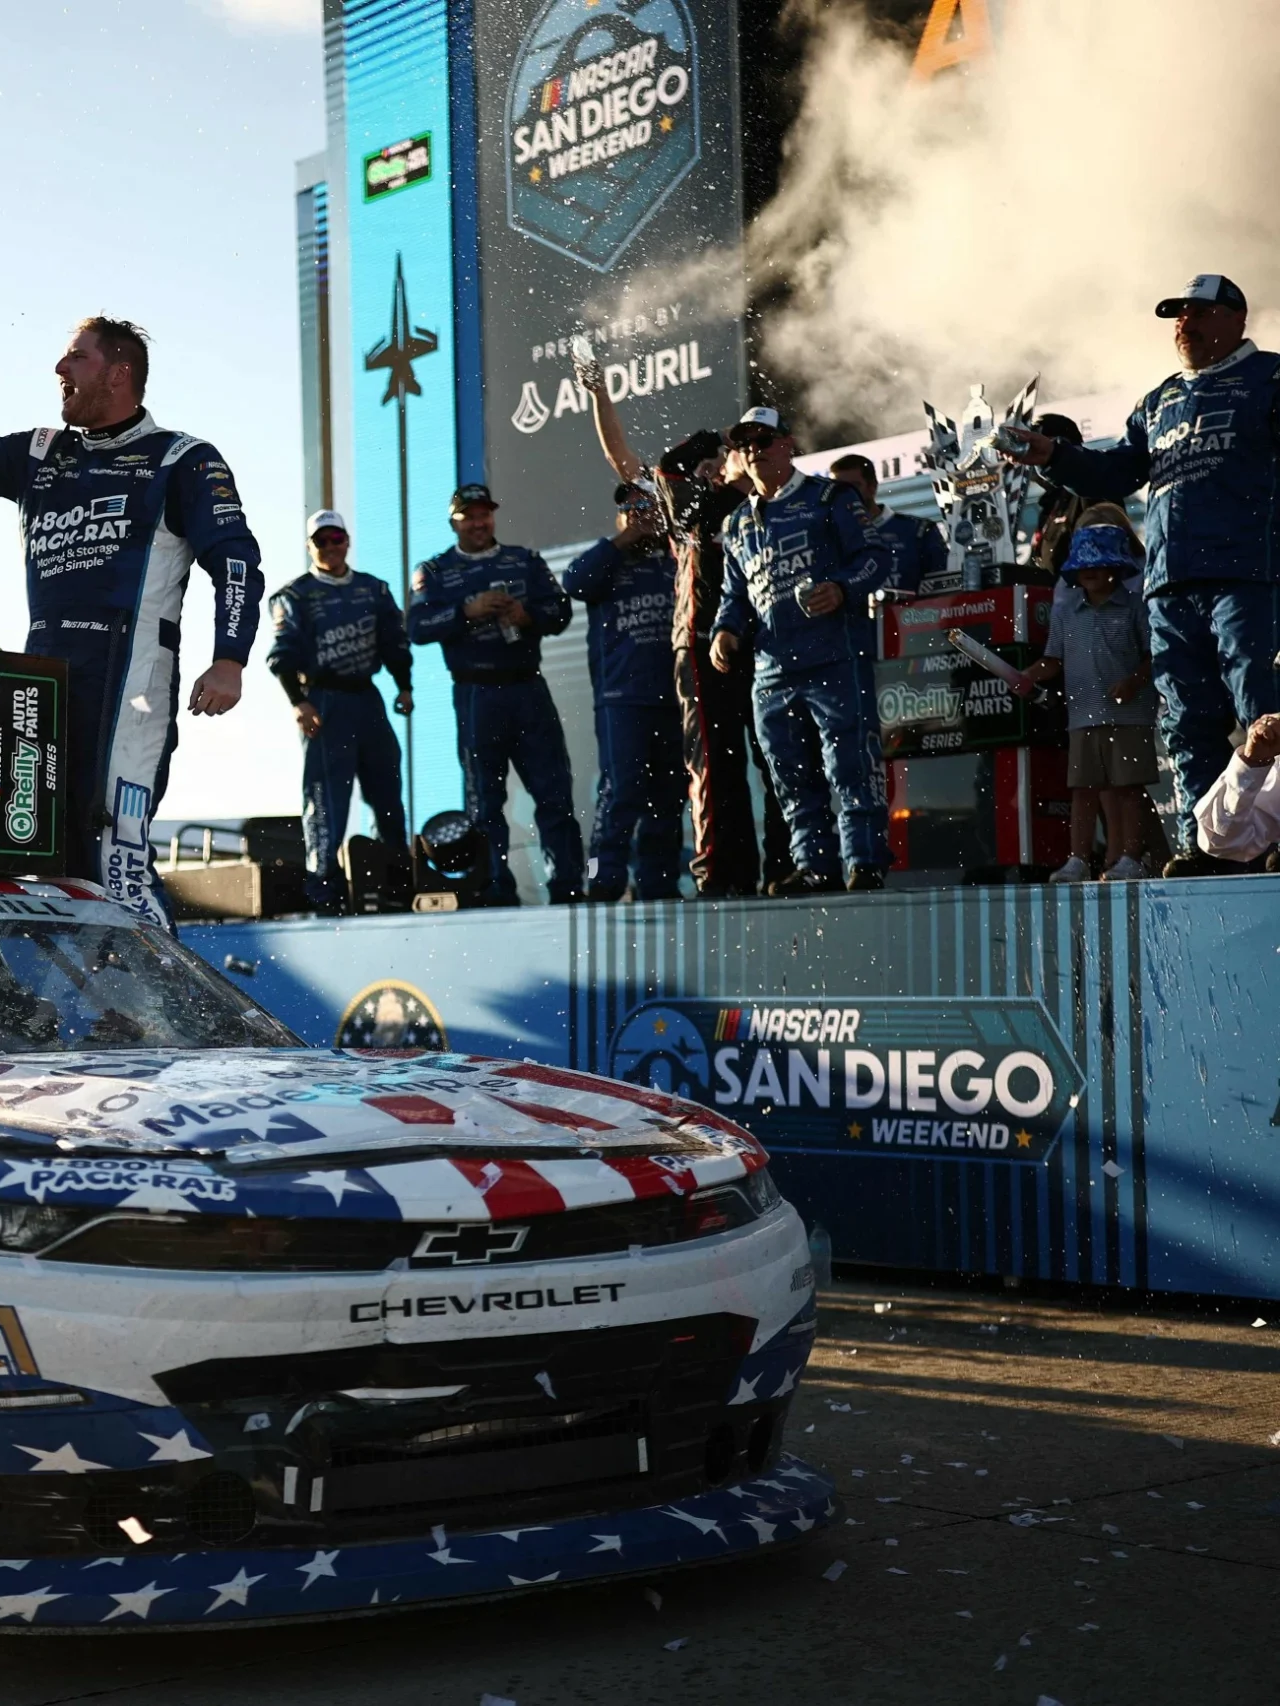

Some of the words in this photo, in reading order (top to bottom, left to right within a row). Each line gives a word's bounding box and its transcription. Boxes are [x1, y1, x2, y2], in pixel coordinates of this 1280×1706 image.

[568, 38, 658, 101] NASCAR
[514, 109, 577, 165] SAN
[582, 66, 688, 142] DIEGO
[548, 119, 652, 180] WEEKEND
[37, 551, 66, 569] Moving
[67, 549, 75, 558] &
[76, 543, 120, 558] Storage
[40, 564, 64, 580] Made
[940, 606, 965, 620] AUTO
[966, 601, 996, 615] PARTS
[923, 652, 972, 673] NASCAR
[879, 684, 962, 724] O'Reilly
[965, 697, 1013, 717] PARTS
[969, 679, 1009, 698] AUTO
[13, 689, 25, 732] AUTO
[26, 686, 39, 739] PARTS
[921, 732, 963, 749] SERIES
[46, 744, 57, 791] SERIES
[7, 739, 39, 842] O'Reilly
[748, 1008, 861, 1043] NASCAR
[714, 1047, 831, 1108] SAN
[846, 1049, 1054, 1117] DIEGO
[872, 1118, 1010, 1149] WEEKEND
[349, 1282, 626, 1324] CHEVROLET
